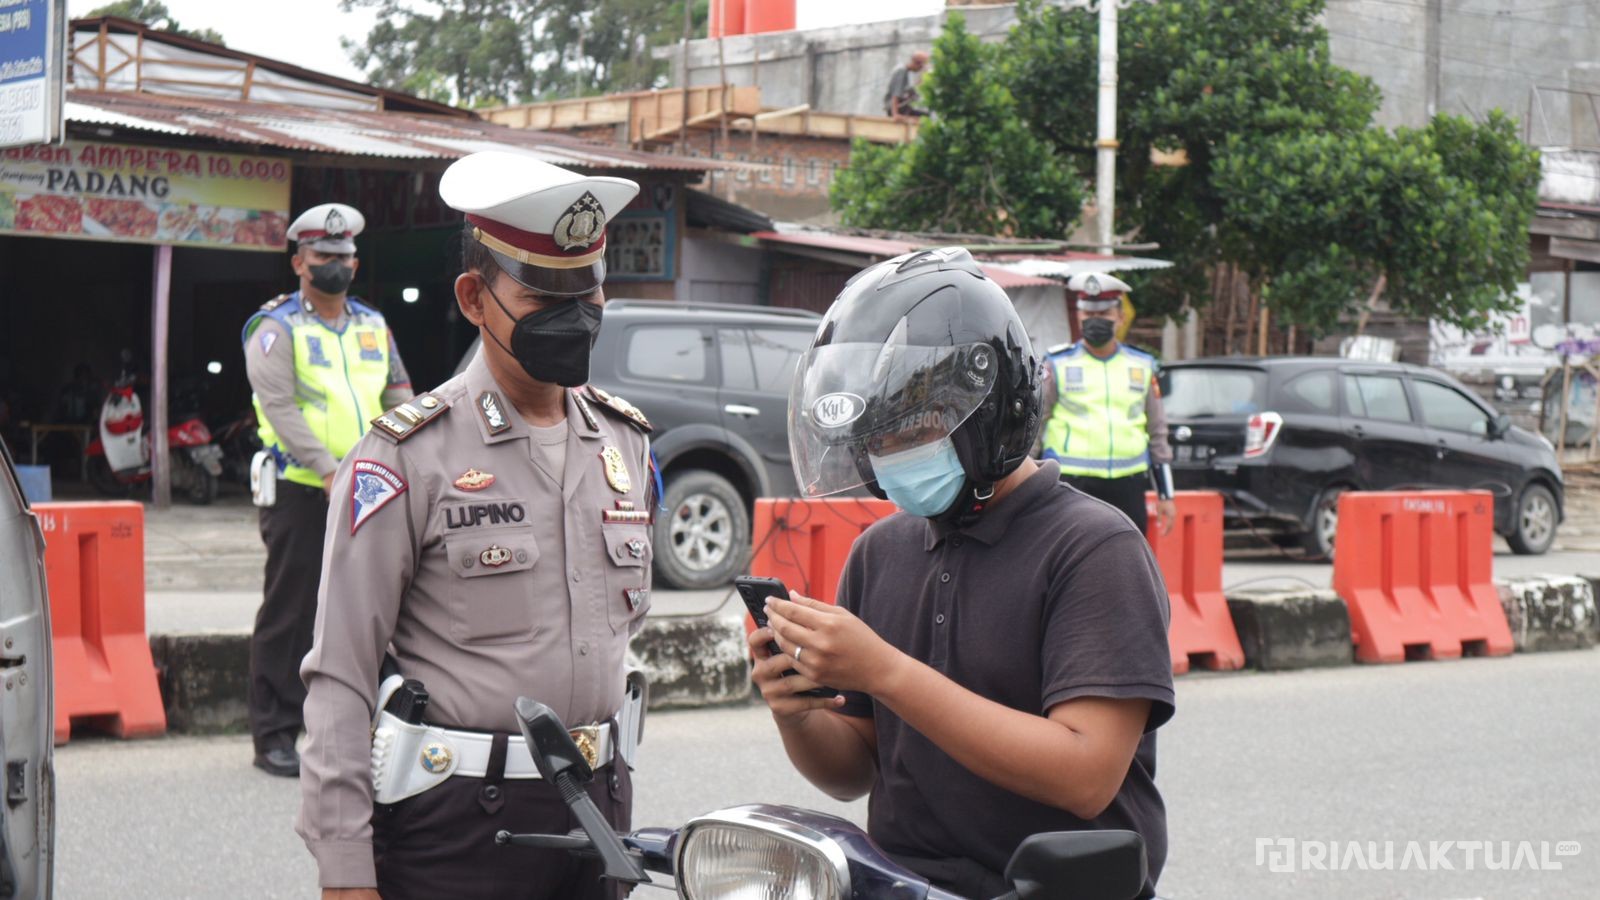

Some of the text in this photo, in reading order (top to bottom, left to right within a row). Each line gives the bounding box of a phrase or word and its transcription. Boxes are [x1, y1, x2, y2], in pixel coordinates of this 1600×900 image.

[78, 145, 202, 177] AMPERA
[208, 155, 287, 181] 10.000
[46, 169, 170, 199] PADANG
[446, 503, 525, 529] LUPINO
